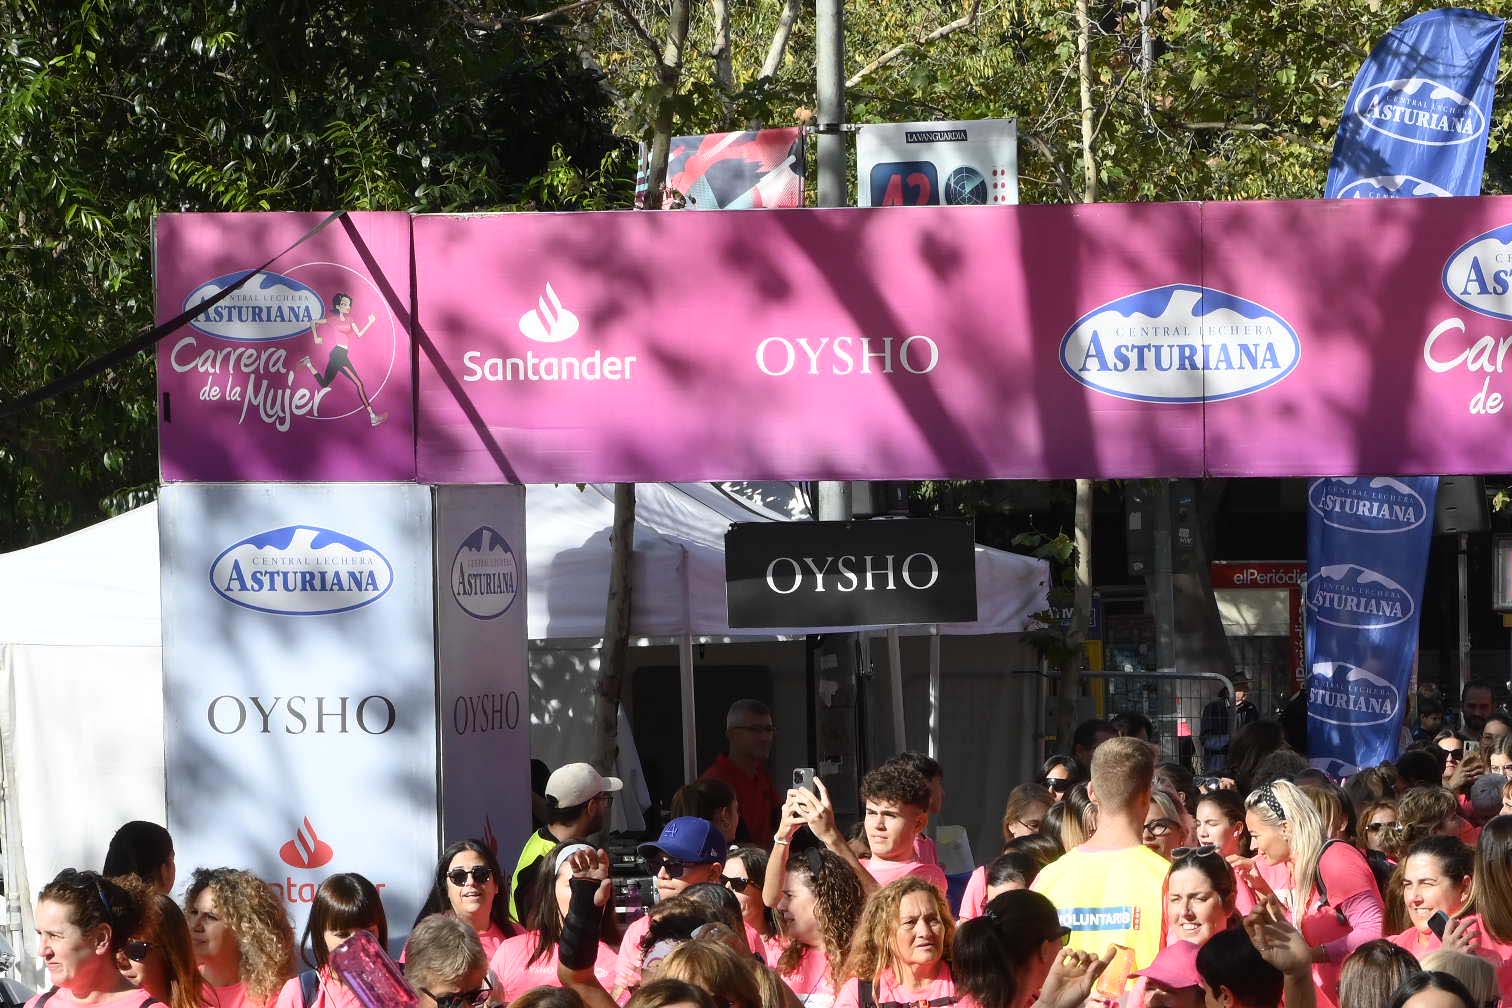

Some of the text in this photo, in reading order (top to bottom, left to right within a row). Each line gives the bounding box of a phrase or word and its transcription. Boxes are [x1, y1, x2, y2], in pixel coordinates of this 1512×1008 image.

[1363, 94, 1474, 135] ASTURIANA
[194, 296, 313, 323] ASTURIANA
[222, 294, 259, 302] NTRAL
[1114, 325, 1273, 338] CENTRAL LECHERA
[170, 336, 287, 374] Carrera
[463, 350, 637, 382] Santander
[755, 334, 940, 377] OYSHO
[1078, 330, 1282, 373] ASTURIANA
[199, 370, 332, 433] de la Mujer
[1468, 375, 1504, 414] de
[223, 558, 381, 593] ASTURIANA
[251, 556, 375, 566] CENTRAL LECHERA
[455, 560, 517, 596] ASTURIANA
[765, 552, 940, 596] OYSHO
[1314, 588, 1403, 618] STURIANA
[207, 694, 397, 735] OYSHO
[453, 690, 521, 735] OYSHO
[1308, 687, 1393, 715] STURIANA
